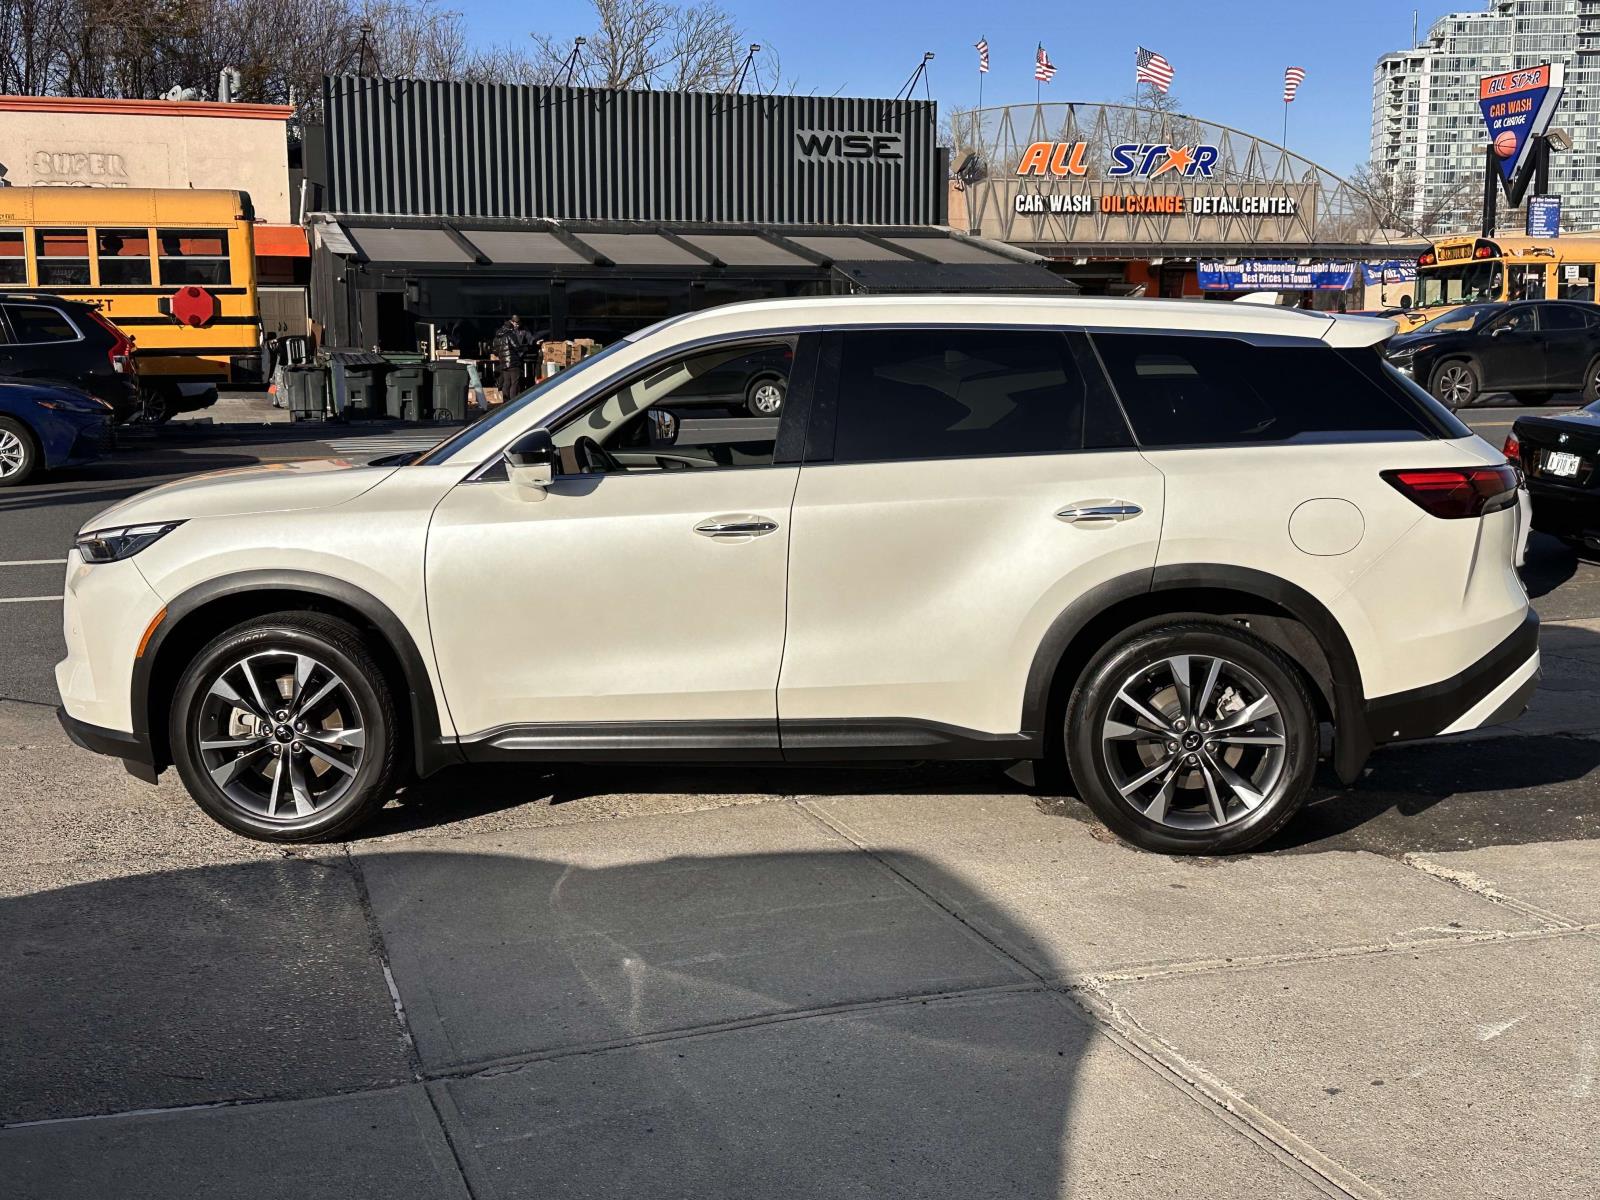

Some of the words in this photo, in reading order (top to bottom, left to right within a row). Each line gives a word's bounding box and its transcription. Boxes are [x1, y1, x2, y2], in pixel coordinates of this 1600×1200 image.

[1488, 77, 1507, 94] ALL
[1489, 102, 1506, 118] CAR
[1507, 97, 1533, 114] WASH
[1503, 115, 1527, 128] CHANGE
[796, 133, 903, 159] WISE
[34, 150, 128, 177] SUPER
[1016, 140, 1089, 177] ALL
[1107, 142, 1220, 179] STAR
[1015, 194, 1044, 212] CAR
[1049, 194, 1091, 212] WASH
[1101, 195, 1125, 213] OIL
[1126, 196, 1183, 214] CHANGE
[1193, 196, 1240, 213] DETAIL
[1242, 197, 1295, 214] CENTER
[1246, 263, 1252, 272] &
[1253, 262, 1296, 273] Shampooing
[1296, 263, 1328, 273] Available
[1242, 273, 1258, 283] Best
[1259, 273, 1281, 283] Prices
[1290, 273, 1311, 283] Town!
